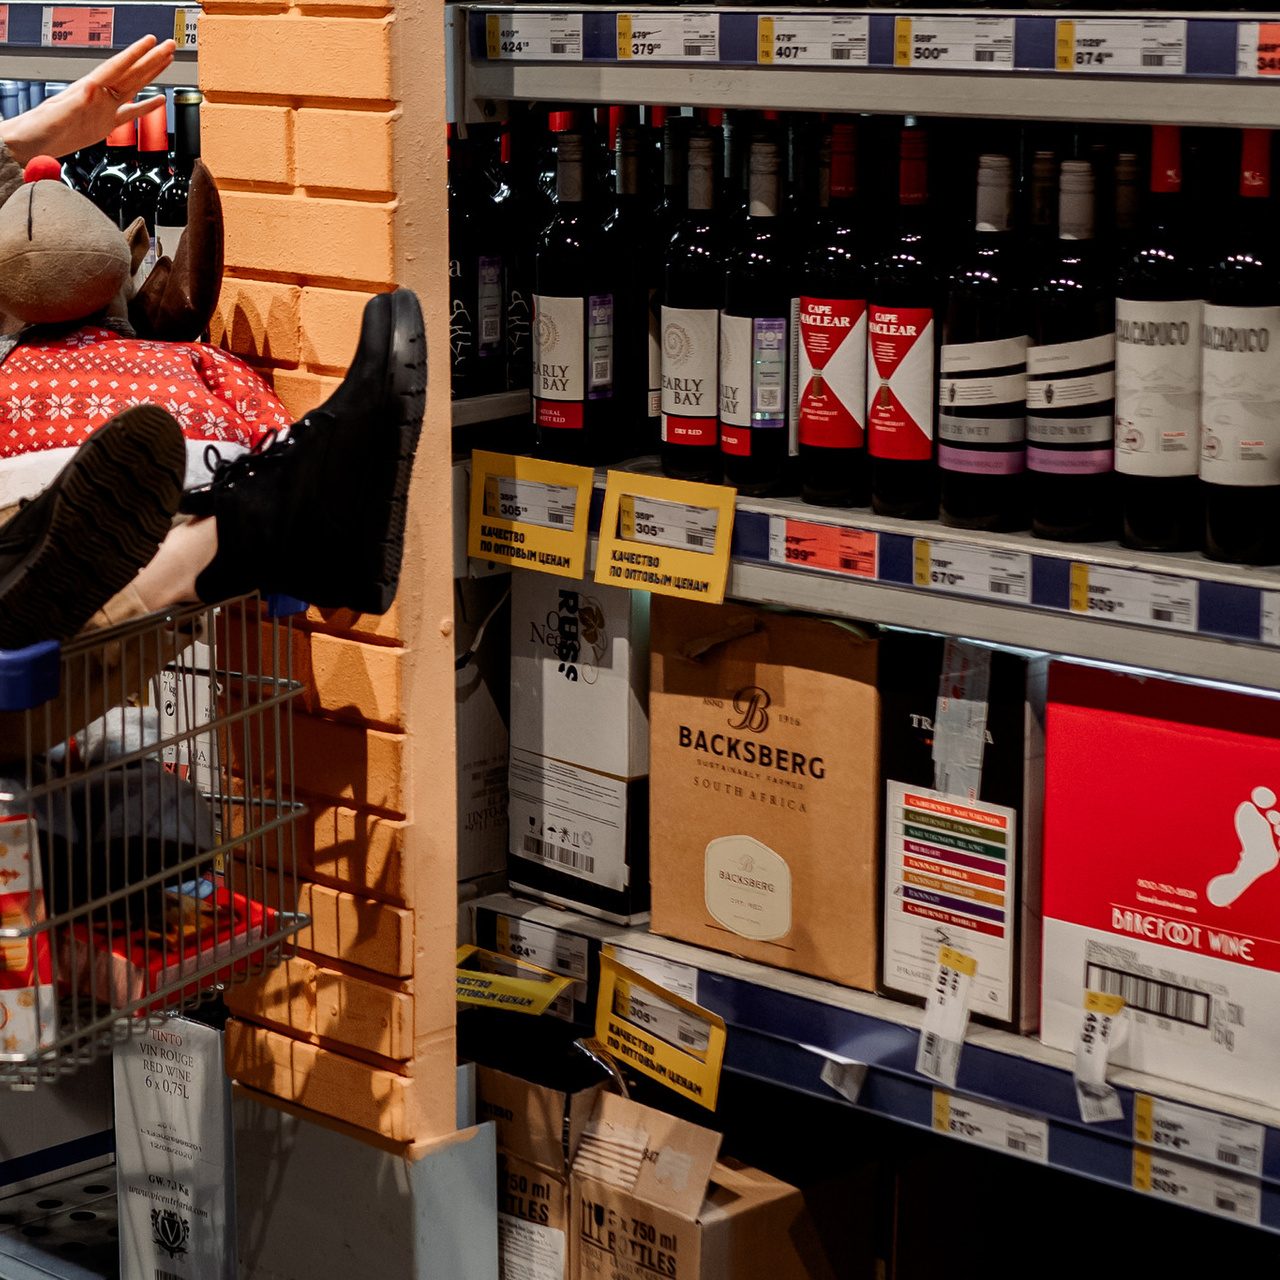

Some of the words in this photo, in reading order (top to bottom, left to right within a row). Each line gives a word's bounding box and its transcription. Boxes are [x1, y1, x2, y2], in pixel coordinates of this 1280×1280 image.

[51, 30, 68, 41] 699
[501, 41, 523, 53] 424
[631, 43, 654, 55] 379
[775, 46, 799, 59] 407
[914, 46, 940, 59] 500
[808, 304, 832, 314] CAPE
[875, 312, 898, 323] CAPE
[542, 378, 570, 392] BAY
[673, 391, 704, 406] BAY
[500, 504, 521, 516] 305
[481, 525, 525, 544] КАЧЕСТВО
[635, 522, 658, 536] 305
[480, 540, 492, 552] ПО
[493, 542, 537, 562] ОПТОВЫМ
[538, 551, 570, 569] ЦЕНАМ
[611, 549, 660, 568] КАЧЕСТВО
[609, 566, 622, 578] ПО
[624, 567, 672, 587] ОПТОВЫМ
[674, 576, 709, 594] ЦЕНАМ
[678, 724, 826, 780] BACKSBERG
[693, 776, 743, 797] SOUTH
[749, 789, 807, 813] AFRICA
[719, 869, 775, 893] BACKSBERG
[1111, 907, 1202, 949] BAREFOOT
[1208, 930, 1255, 961] WINE
[149, 1027, 183, 1047] TINTO
[607, 1020, 655, 1056] КАЧЕСТВО
[139, 1043, 158, 1059] VIN
[160, 1049, 194, 1068] ROUGE
[143, 1058, 163, 1074] RED
[166, 1064, 191, 1083] WINE
[145, 1075, 153, 1089] 6
[154, 1082, 161, 1091] x
[162, 1080, 190, 1100] 0,75L
[178, 1183, 190, 1197] Kg
[532, 1182, 550, 1201] ml
[128, 1184, 209, 1219] www.vicentefaria.com
[631, 1218, 656, 1243] 750
[659, 1233, 678, 1252] ml
[608, 1229, 678, 1277] BOTTLES
